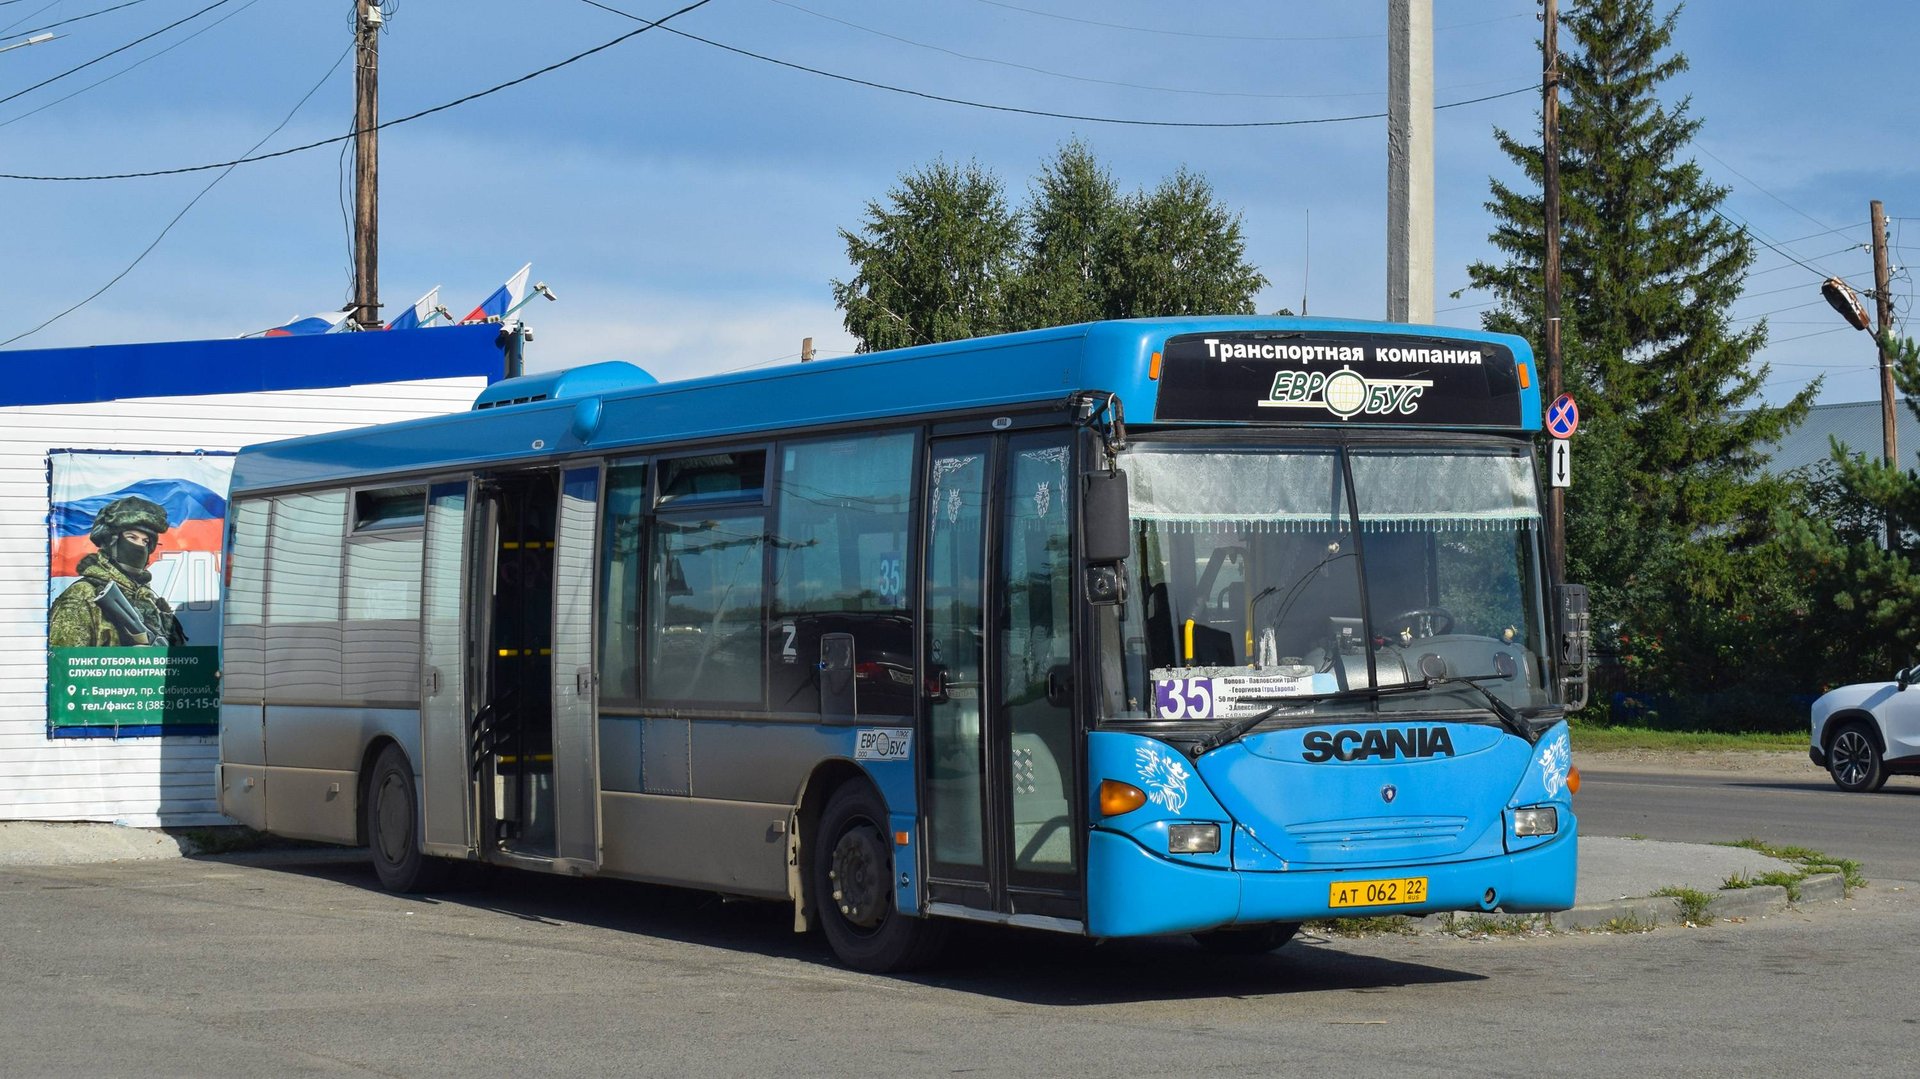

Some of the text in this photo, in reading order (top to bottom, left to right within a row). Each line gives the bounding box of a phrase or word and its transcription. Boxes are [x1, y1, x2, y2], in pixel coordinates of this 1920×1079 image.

[1204, 339, 1482, 365] Транспортная компания
[880, 559, 900, 596] 35
[782, 625, 797, 656] Z
[68, 657, 199, 666] ПУНКТ ОТБОРА НА ВОЕННУЮ
[68, 669, 107, 677] СЛУЖБУ
[124, 668, 180, 677] КОНТРАКТУ:
[1248, 676, 1283, 684] Павловский
[1284, 676, 1299, 684] тракт
[82, 688, 89, 696] г.
[91, 687, 138, 697] Барнаул,
[140, 688, 156, 698] пр.
[158, 685, 213, 697] Сибирский,
[1159, 677, 1211, 719] 35
[82, 701, 135, 712] тел./факс:
[137, 702, 143, 710] 8
[145, 700, 174, 712] (3852)
[1302, 727, 1455, 762] SCANIA
[1366, 883, 1397, 902] 062
[1407, 880, 1422, 894] 22
